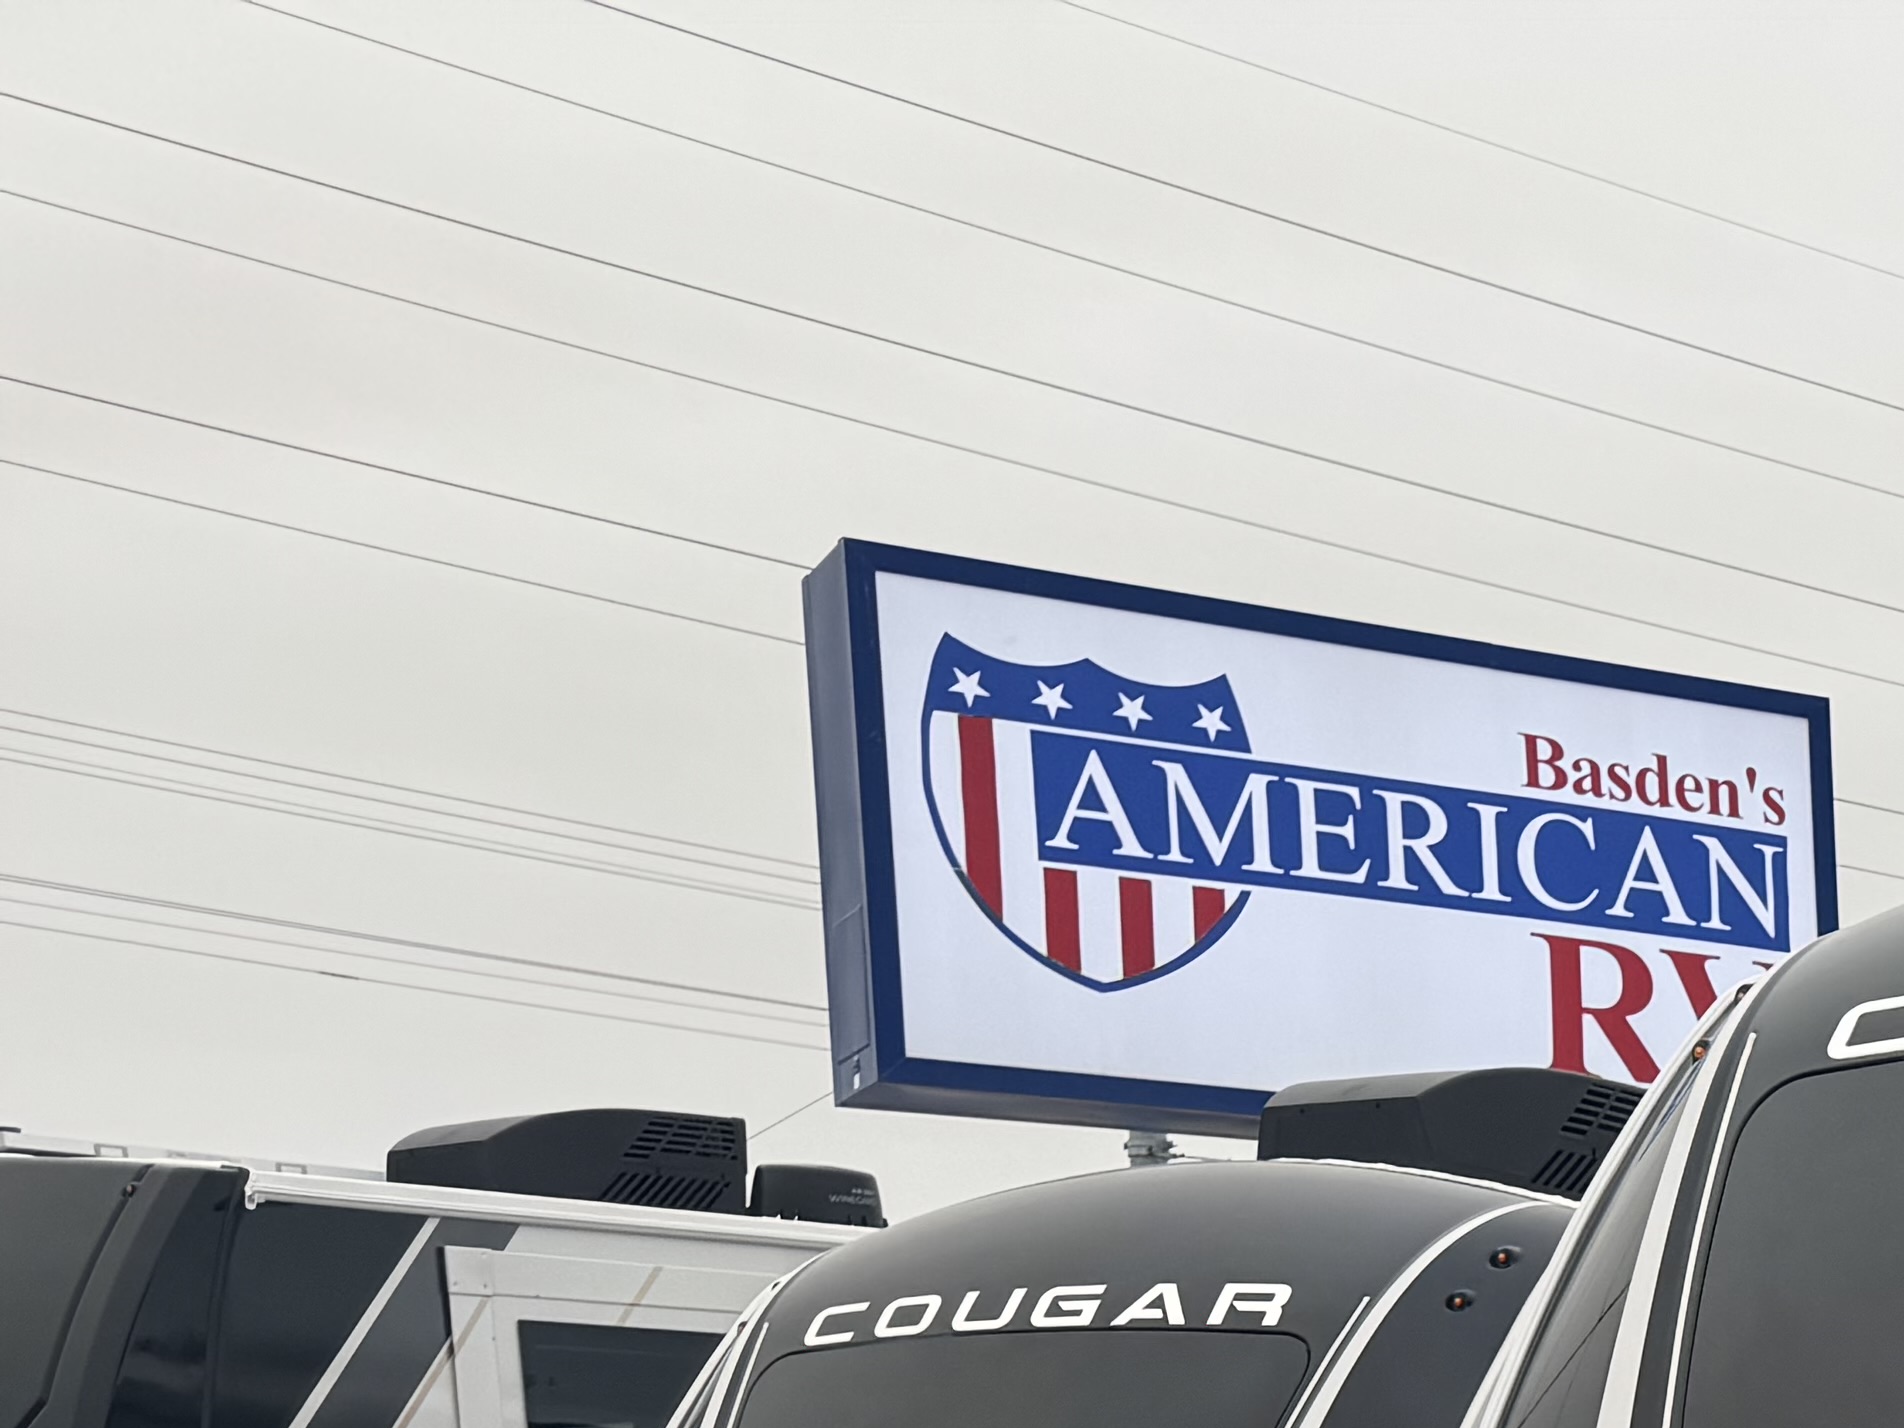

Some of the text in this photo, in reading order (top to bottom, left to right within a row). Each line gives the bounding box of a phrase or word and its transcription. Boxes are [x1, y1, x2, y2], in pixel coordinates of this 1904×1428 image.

[1517, 731, 1787, 827] Basden's
[1044, 749, 1785, 939] AMERICAN
[803, 1282, 1293, 1347] COUGAR
